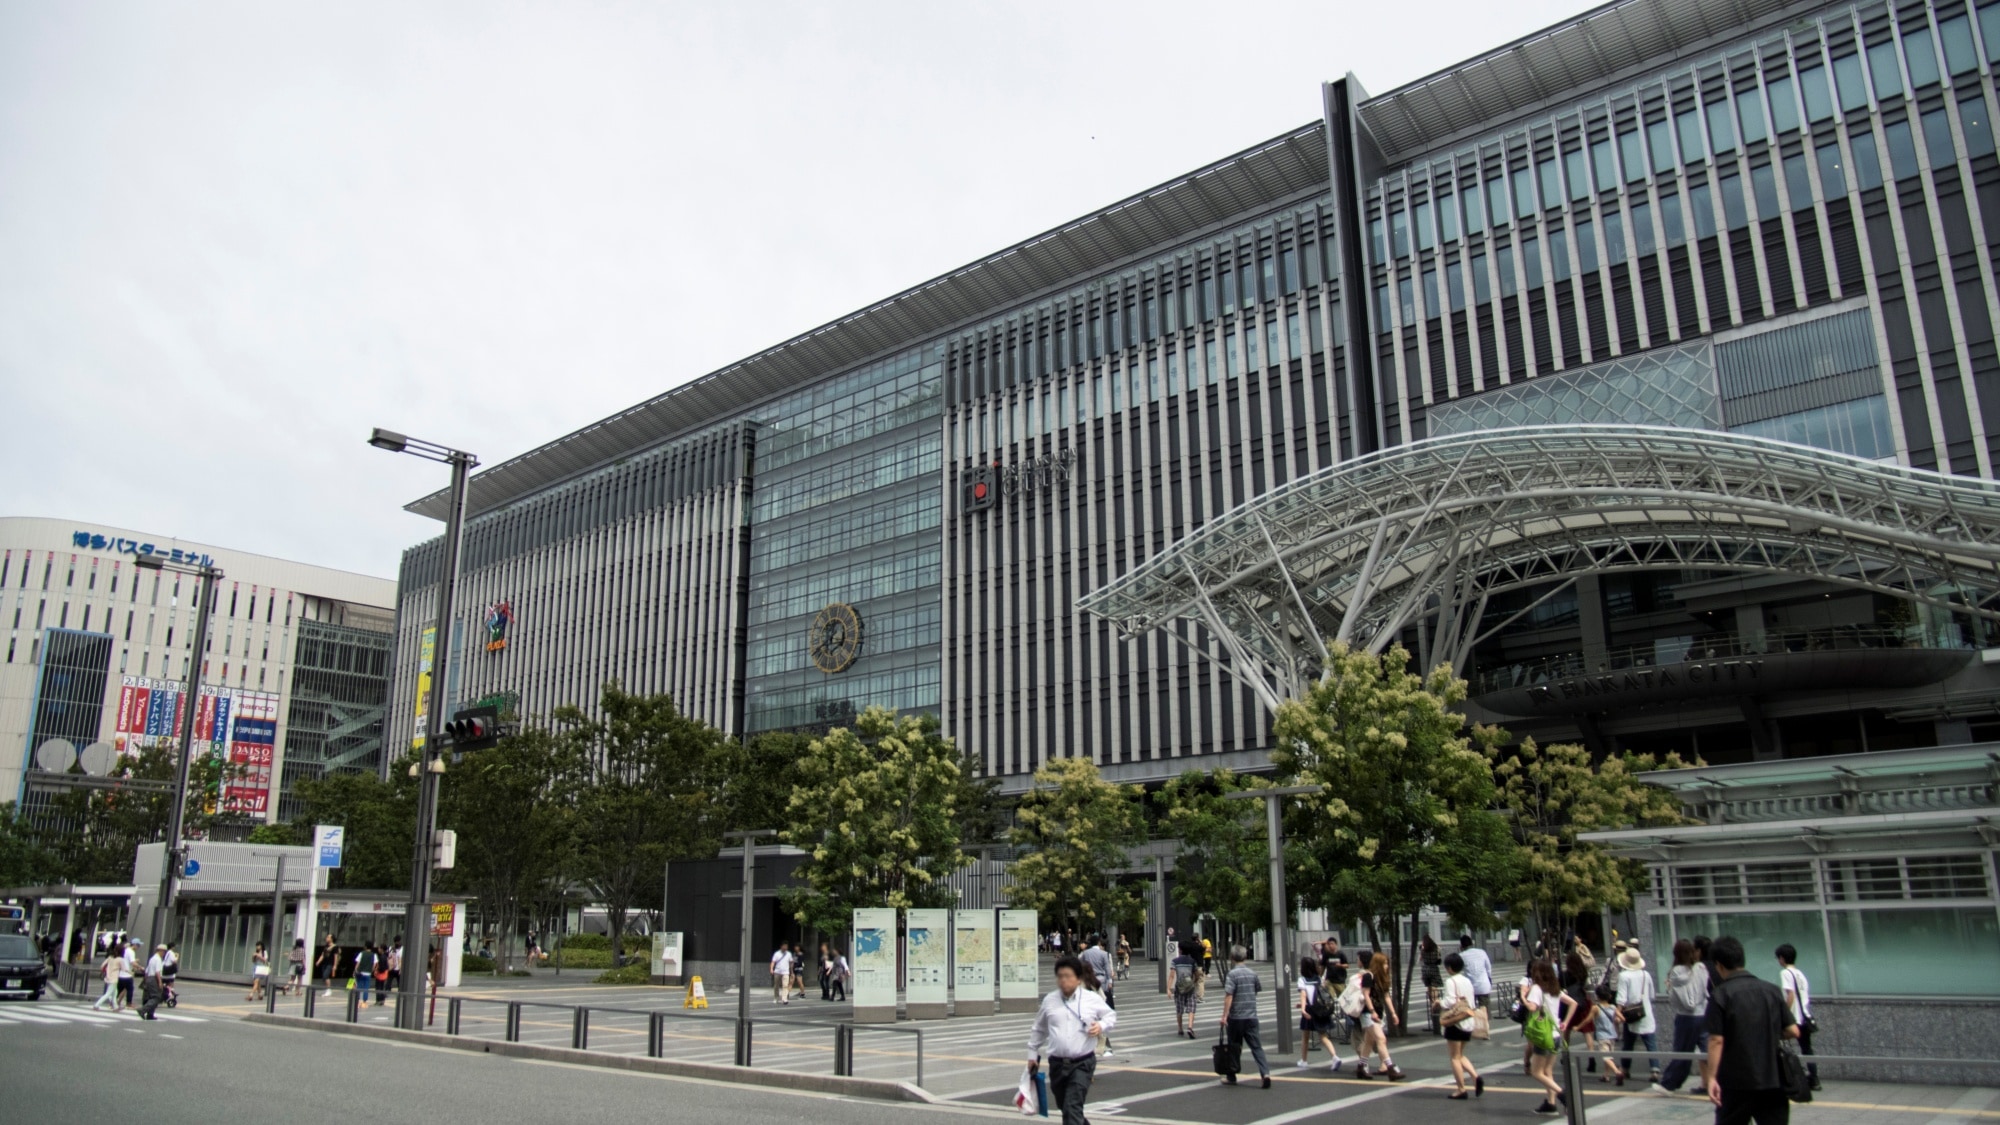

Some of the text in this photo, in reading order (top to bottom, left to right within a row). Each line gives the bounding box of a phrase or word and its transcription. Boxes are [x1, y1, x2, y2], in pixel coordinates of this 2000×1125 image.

[73, 530, 214, 567] 博多バスターミナル
[486, 639, 506, 652] PLAZA
[1558, 668, 1677, 699] HAKATA
[1689, 660, 1764, 683] CITY
[148, 690, 162, 734] ソフトバンク
[238, 703, 274, 712] namco
[233, 745, 270, 756] DAISO
